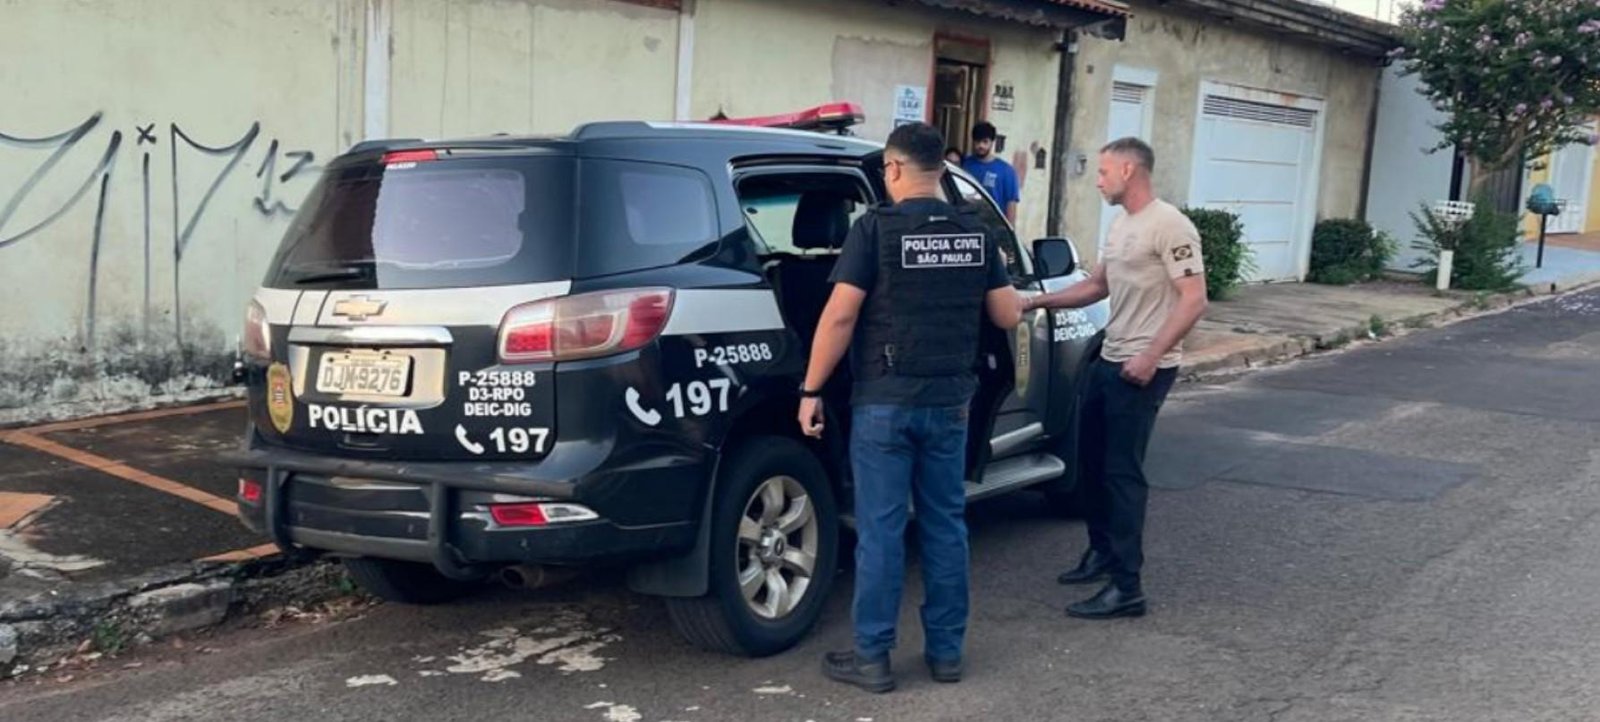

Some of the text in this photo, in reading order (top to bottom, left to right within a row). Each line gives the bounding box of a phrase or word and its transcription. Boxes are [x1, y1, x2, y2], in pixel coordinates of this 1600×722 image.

[905, 237, 981, 251] POLÍCIA CIVIL
[917, 252, 972, 263] SÃO PAULO
[694, 343, 773, 368] P-25888
[458, 371, 536, 387] P-25888
[469, 387, 525, 401] D3-RPO
[666, 378, 731, 418] 197
[464, 402, 532, 416] DEIC-DIG
[308, 403, 424, 434] POLÍCIA
[489, 427, 549, 453] 197
